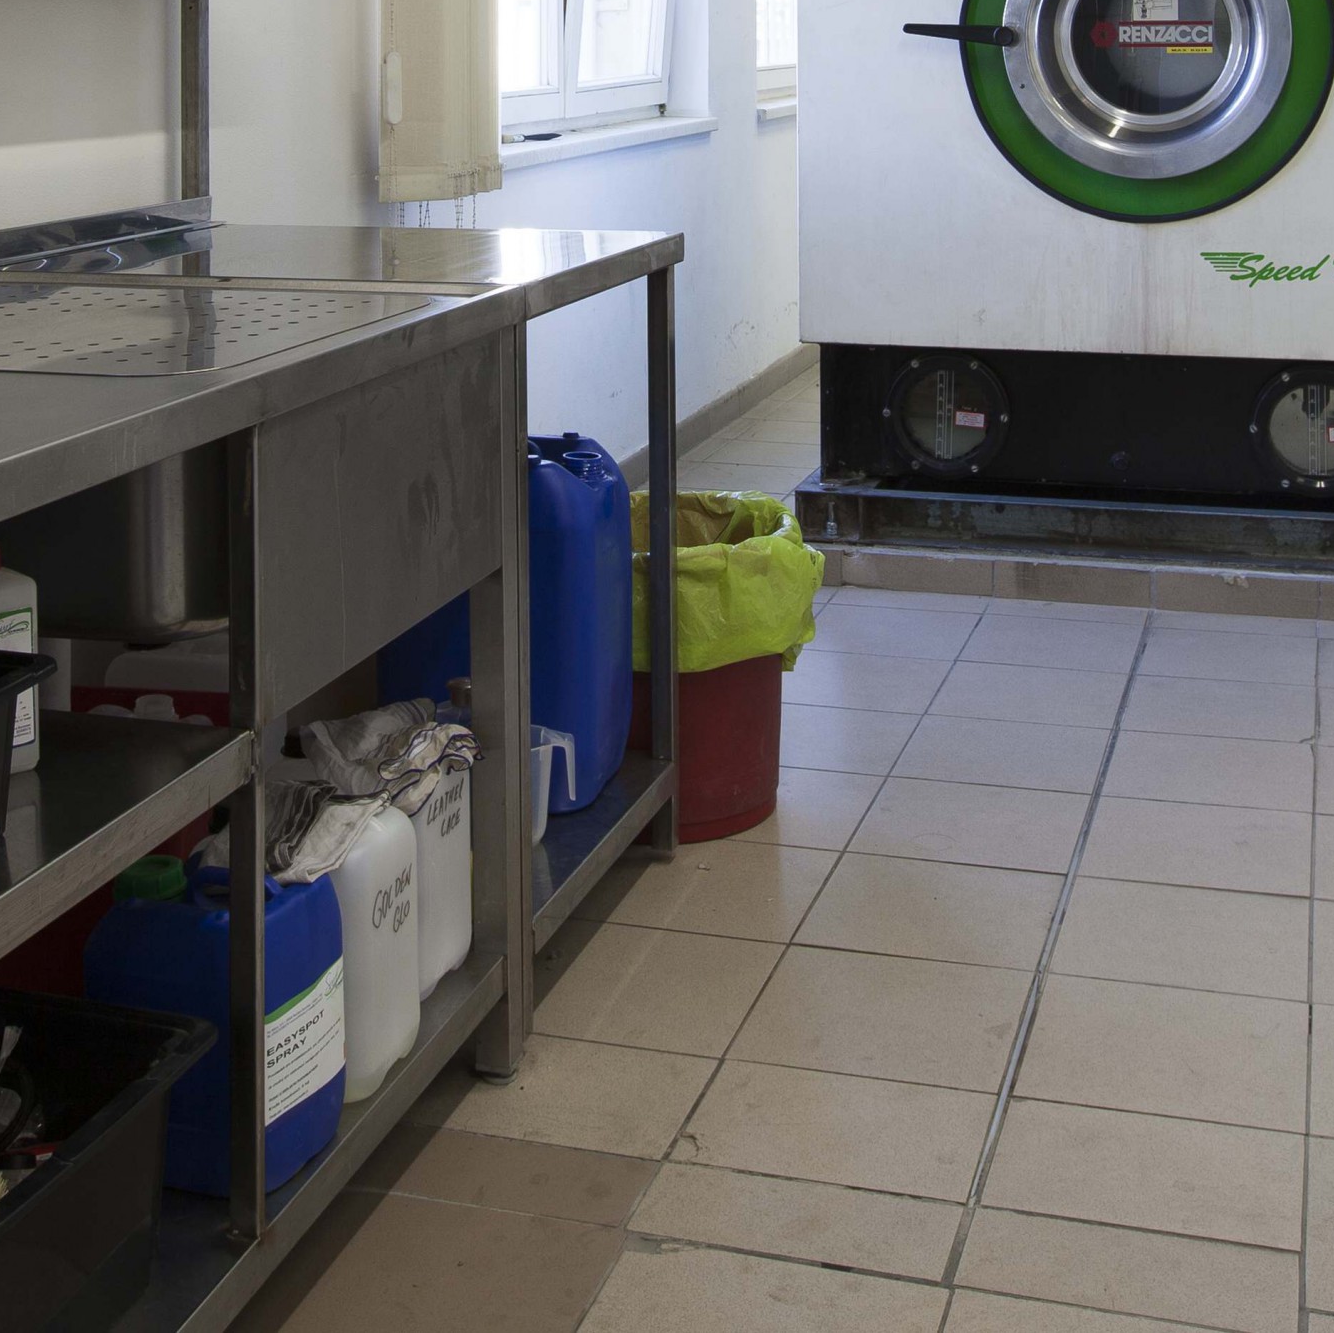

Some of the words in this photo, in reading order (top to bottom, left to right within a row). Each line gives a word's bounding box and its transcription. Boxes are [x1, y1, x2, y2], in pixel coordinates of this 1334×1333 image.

[1119, 26, 1213, 43] RENZACCI
[1230, 254, 1330, 288] Speed
[267, 1009, 325, 1057] EASYSPOT
[267, 1036, 307, 1069] SPRAY
